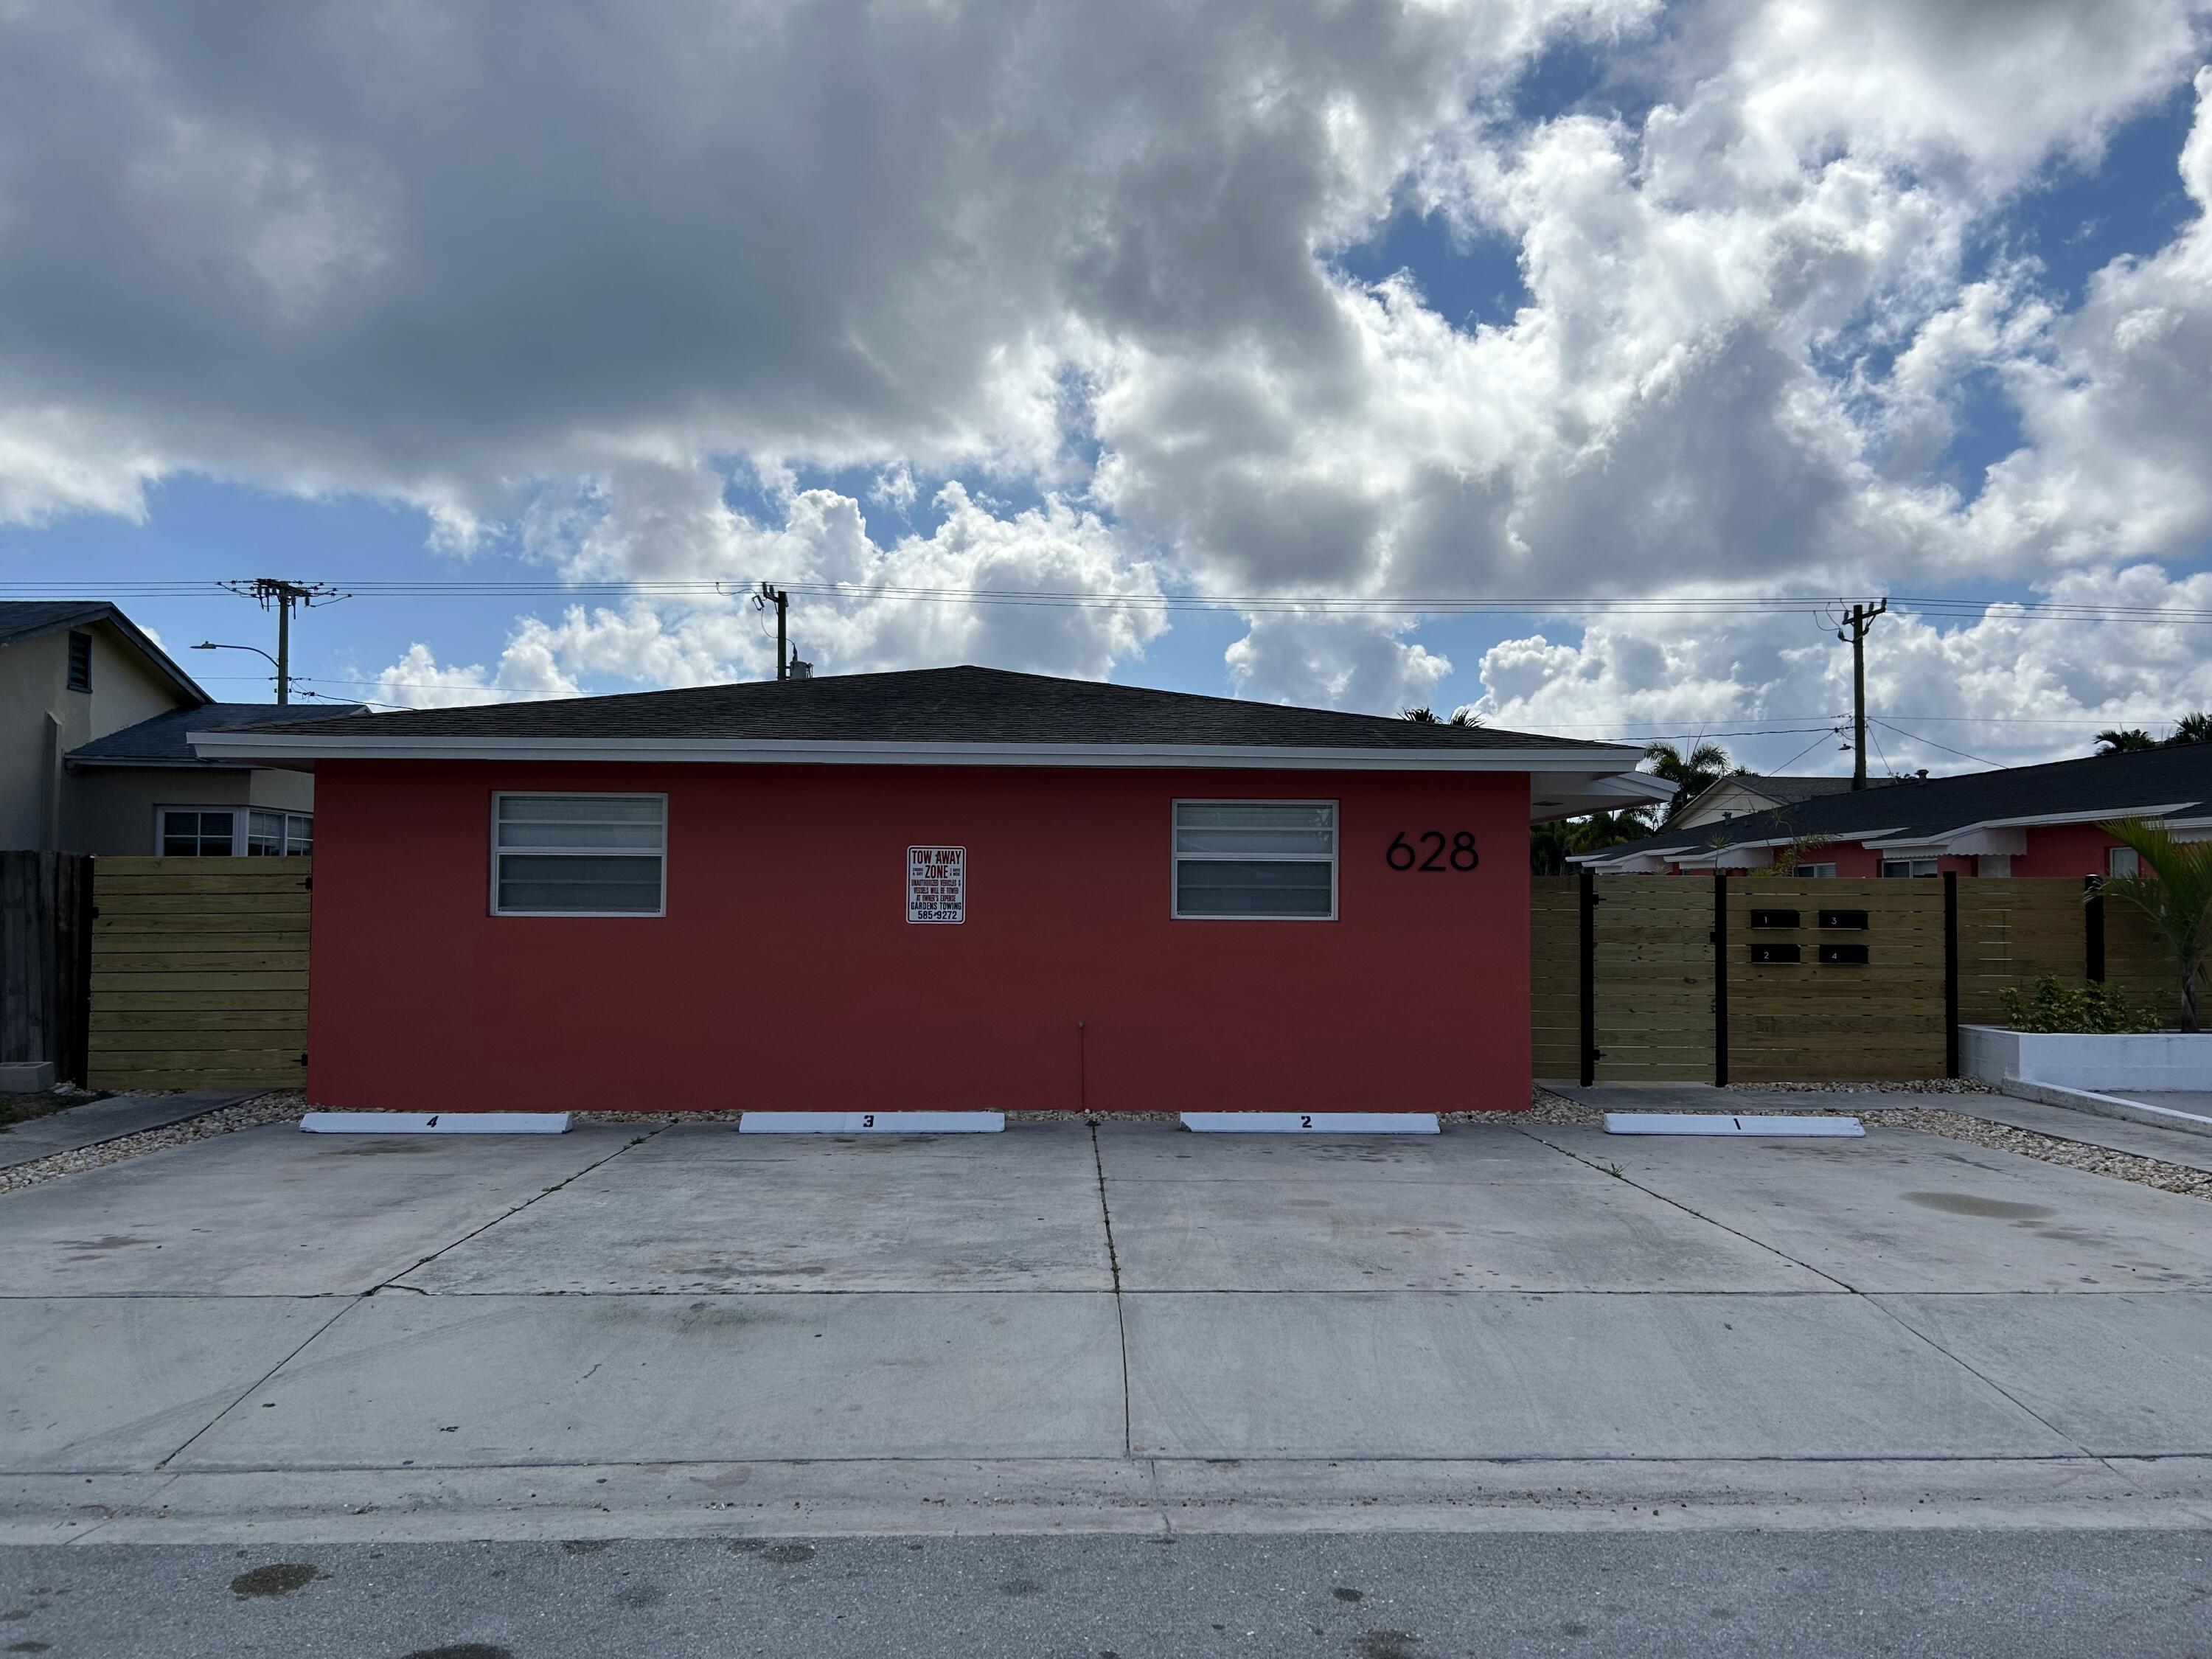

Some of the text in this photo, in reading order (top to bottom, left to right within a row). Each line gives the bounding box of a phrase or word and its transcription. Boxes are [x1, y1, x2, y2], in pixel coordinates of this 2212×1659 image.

[911, 850, 961, 864] TOW AWAY
[1386, 831, 1479, 872] 628
[925, 865, 948, 878] ZONE
[911, 902, 961, 910] GARDENS TOWING
[918, 911, 957, 919] 585-9272
[1764, 916, 1767, 924] 1
[1831, 917, 1837, 925] 3
[426, 1115, 439, 1128] 4
[863, 1115, 874, 1128] 3
[1301, 1115, 1312, 1128] 2
[1733, 1118, 1742, 1130] 1
